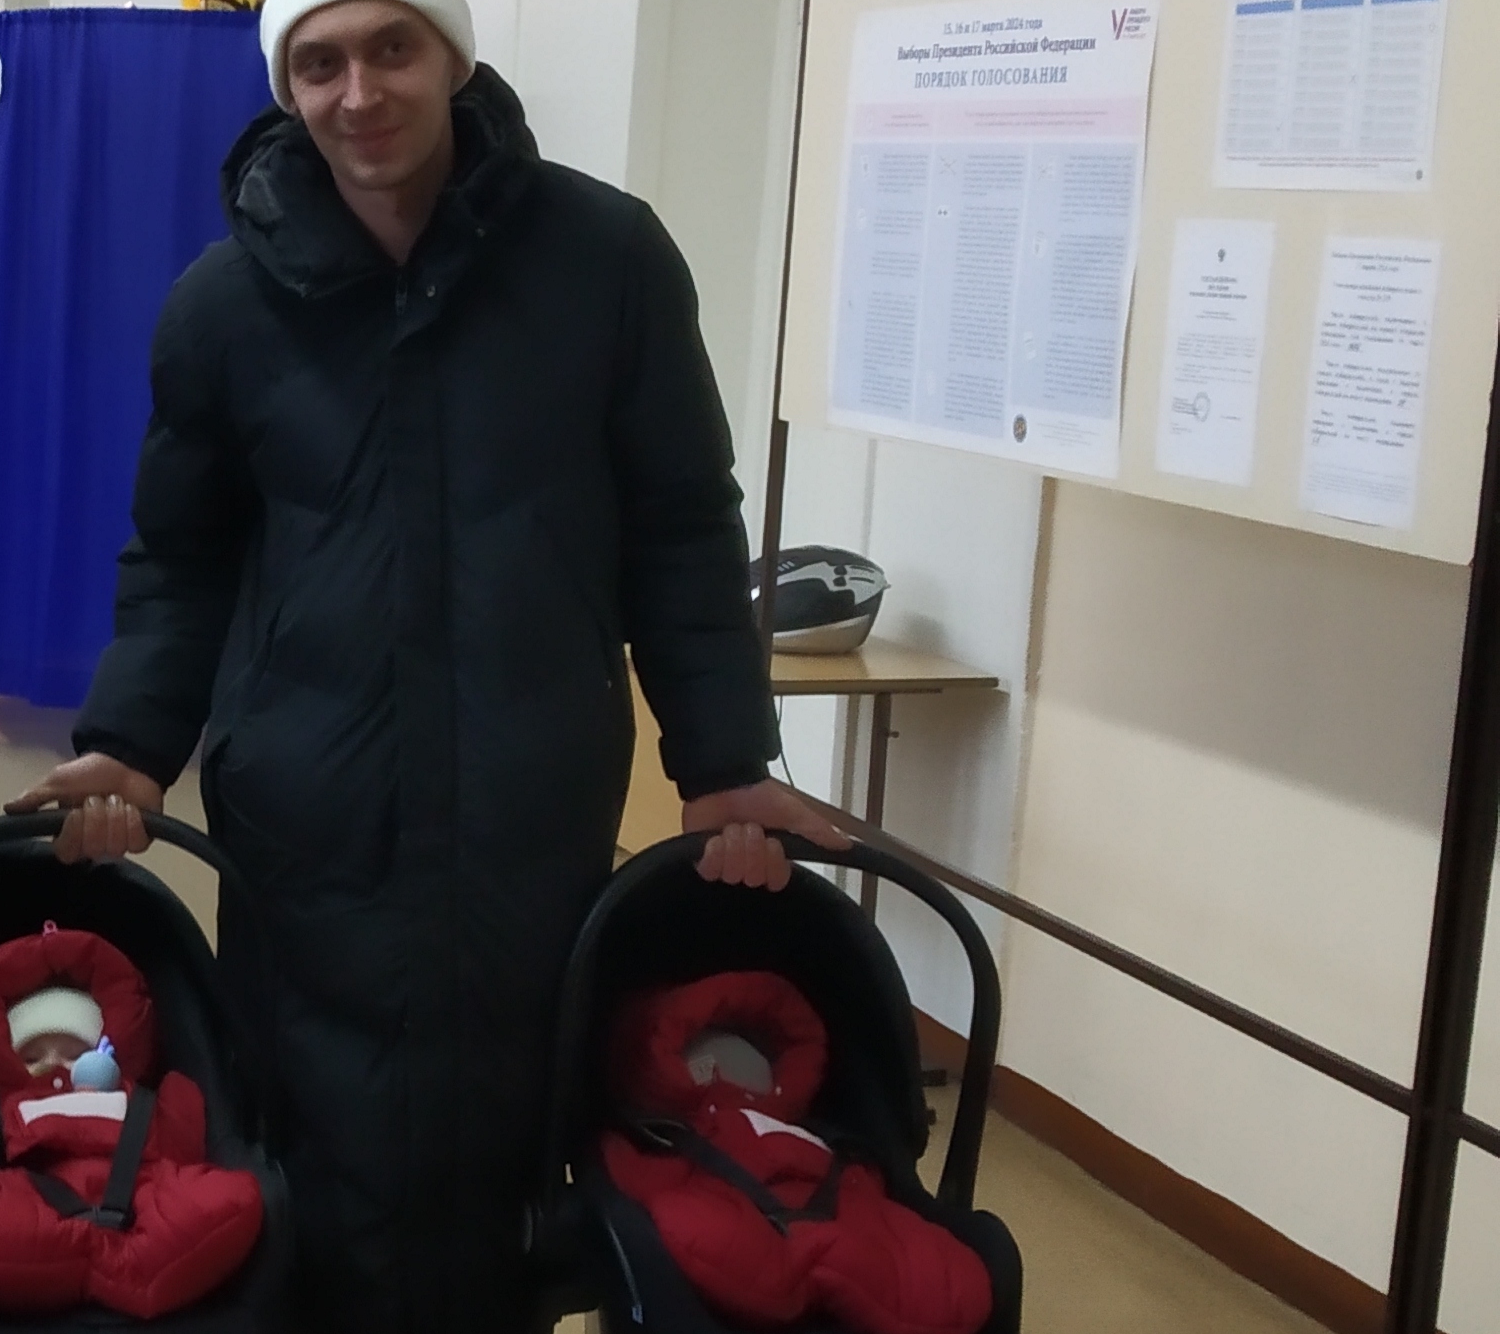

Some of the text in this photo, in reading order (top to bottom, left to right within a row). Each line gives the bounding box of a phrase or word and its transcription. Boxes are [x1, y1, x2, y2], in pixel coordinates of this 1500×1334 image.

[898, 35, 1096, 63] Выборы Президента Российской Федерации
[915, 66, 1068, 88] ПОРЯДОК ГОЛОСОВАНИЯ
